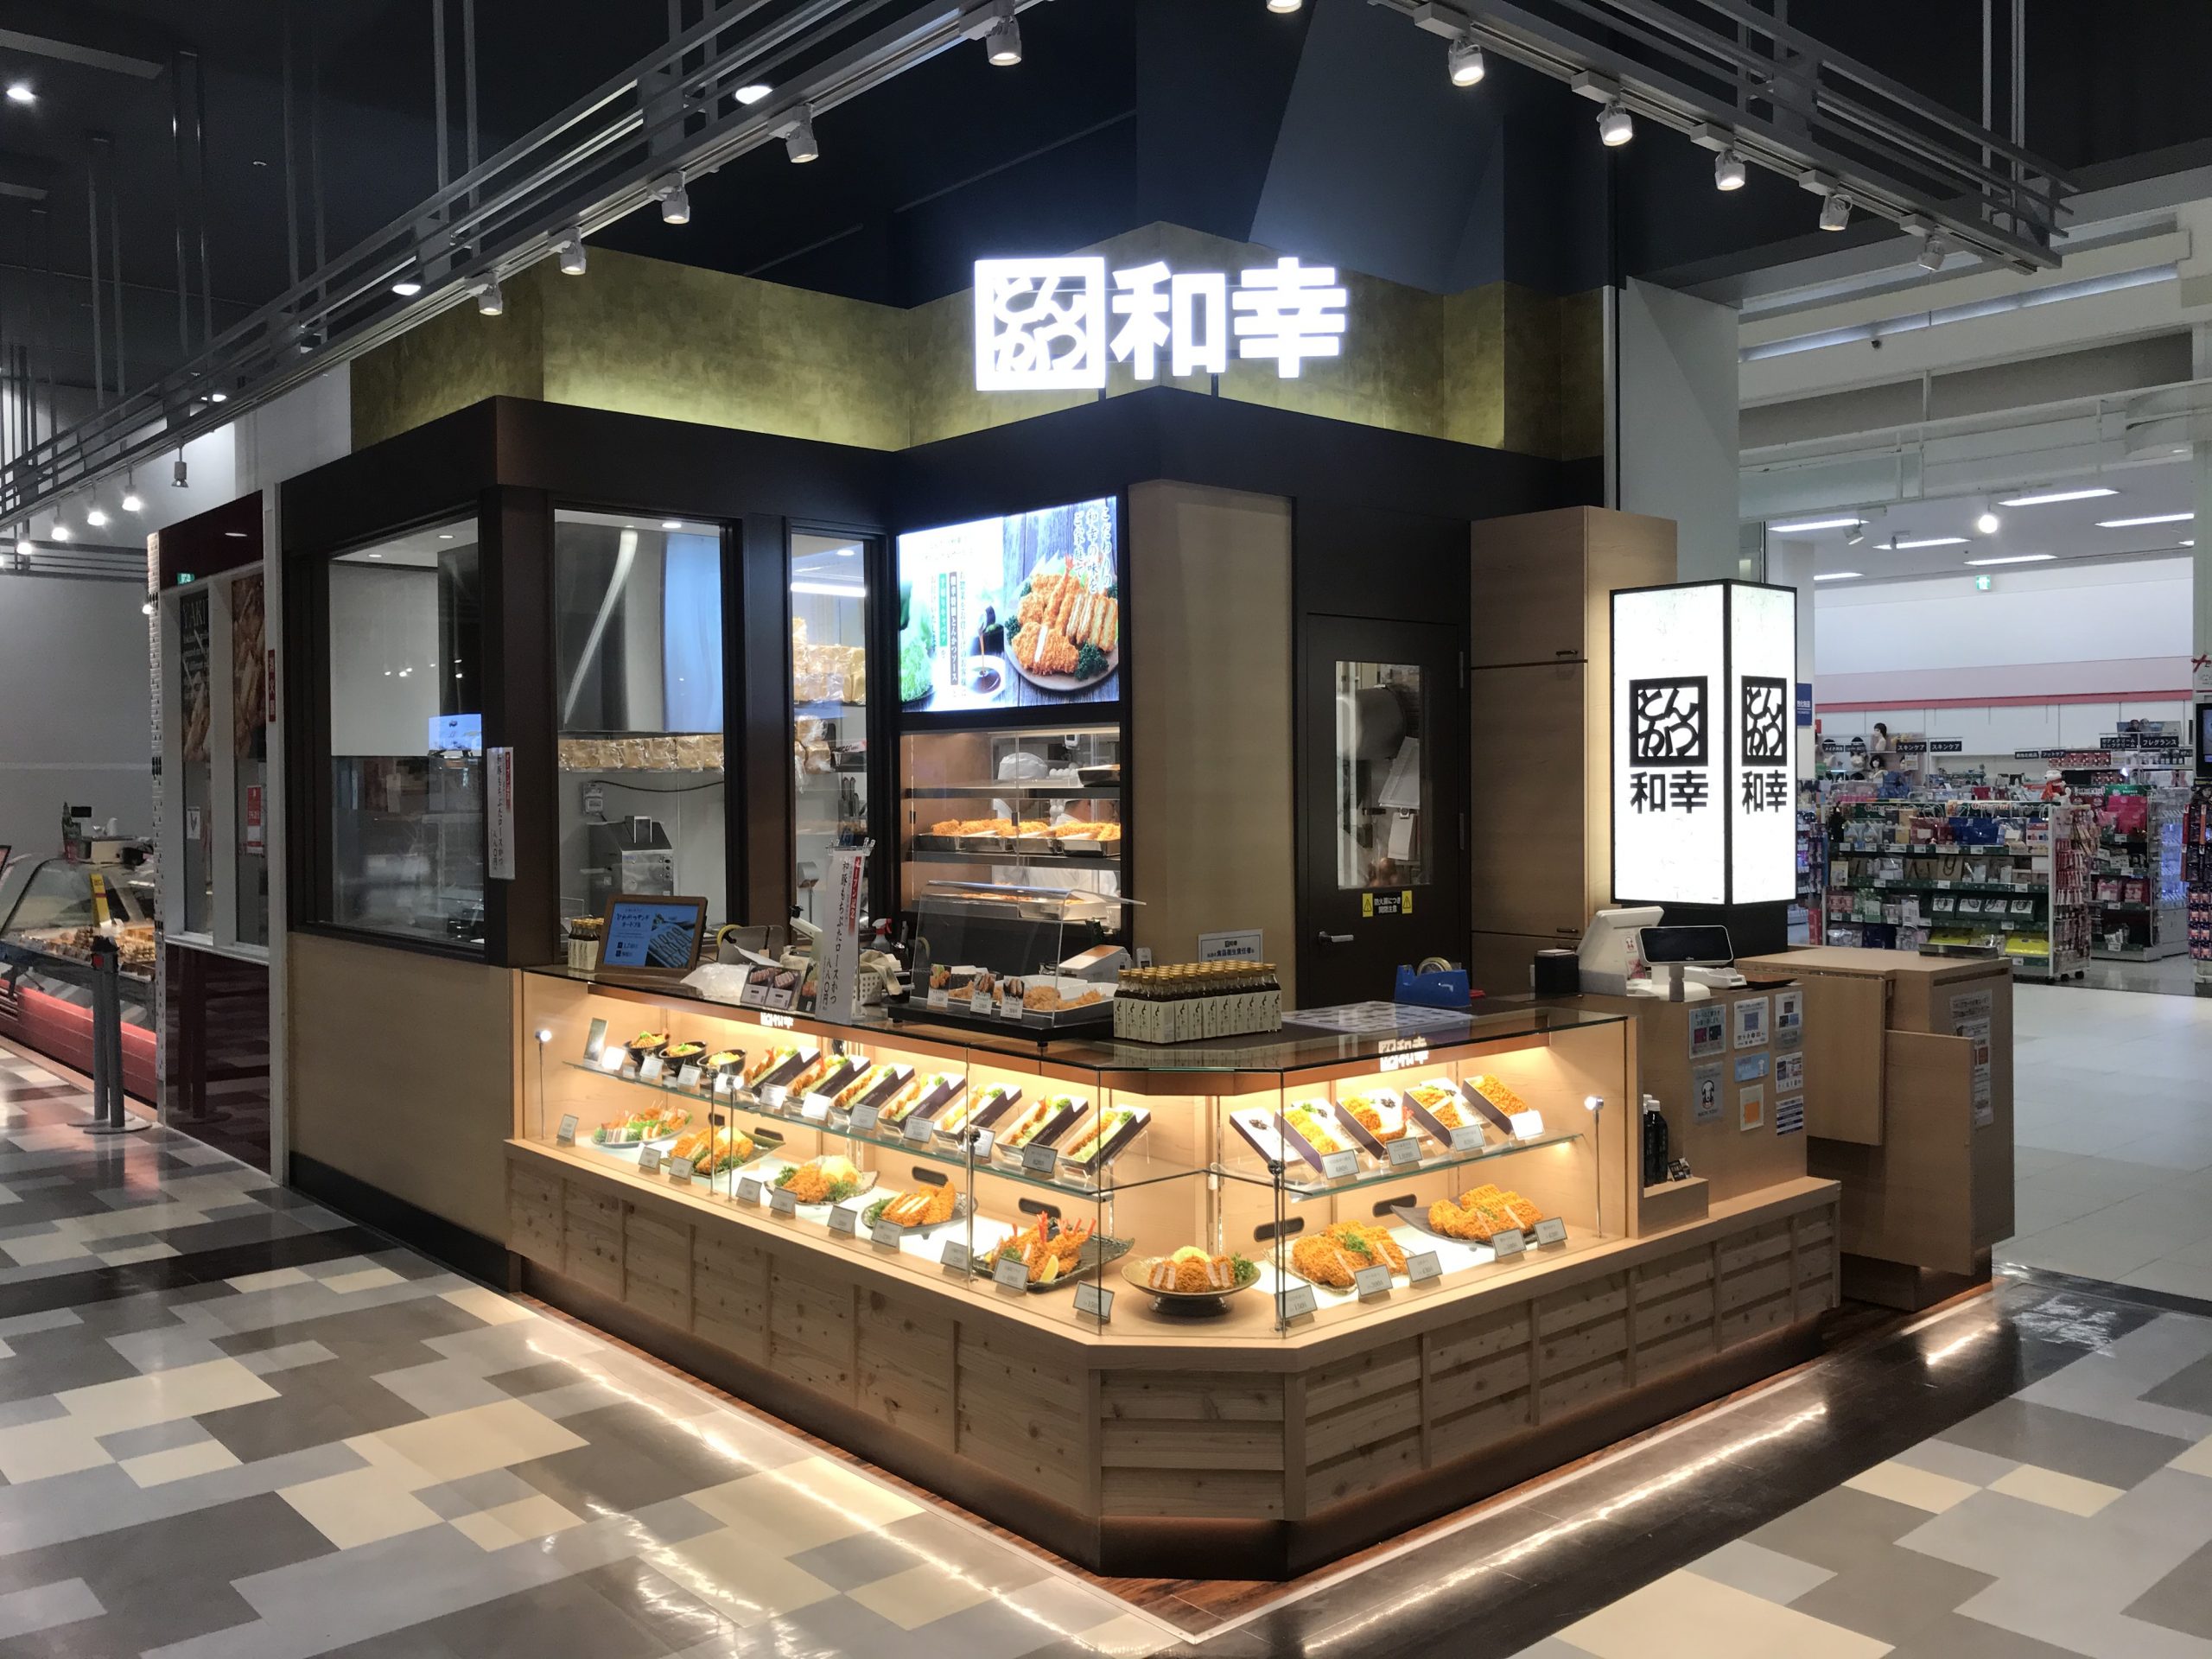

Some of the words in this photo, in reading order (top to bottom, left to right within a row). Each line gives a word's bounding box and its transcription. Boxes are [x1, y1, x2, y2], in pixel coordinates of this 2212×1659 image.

[1109, 257, 1348, 379] 和幸
[181, 597, 208, 629] YAKI
[1634, 682, 1703, 761] とんかつ
[2143, 738, 2177, 747] フレグランス
[1630, 770, 1708, 814] 和幸
[1741, 770, 1787, 814] 和幸
[830, 862, 849, 1004] 和豚もちぶたロースかつ
